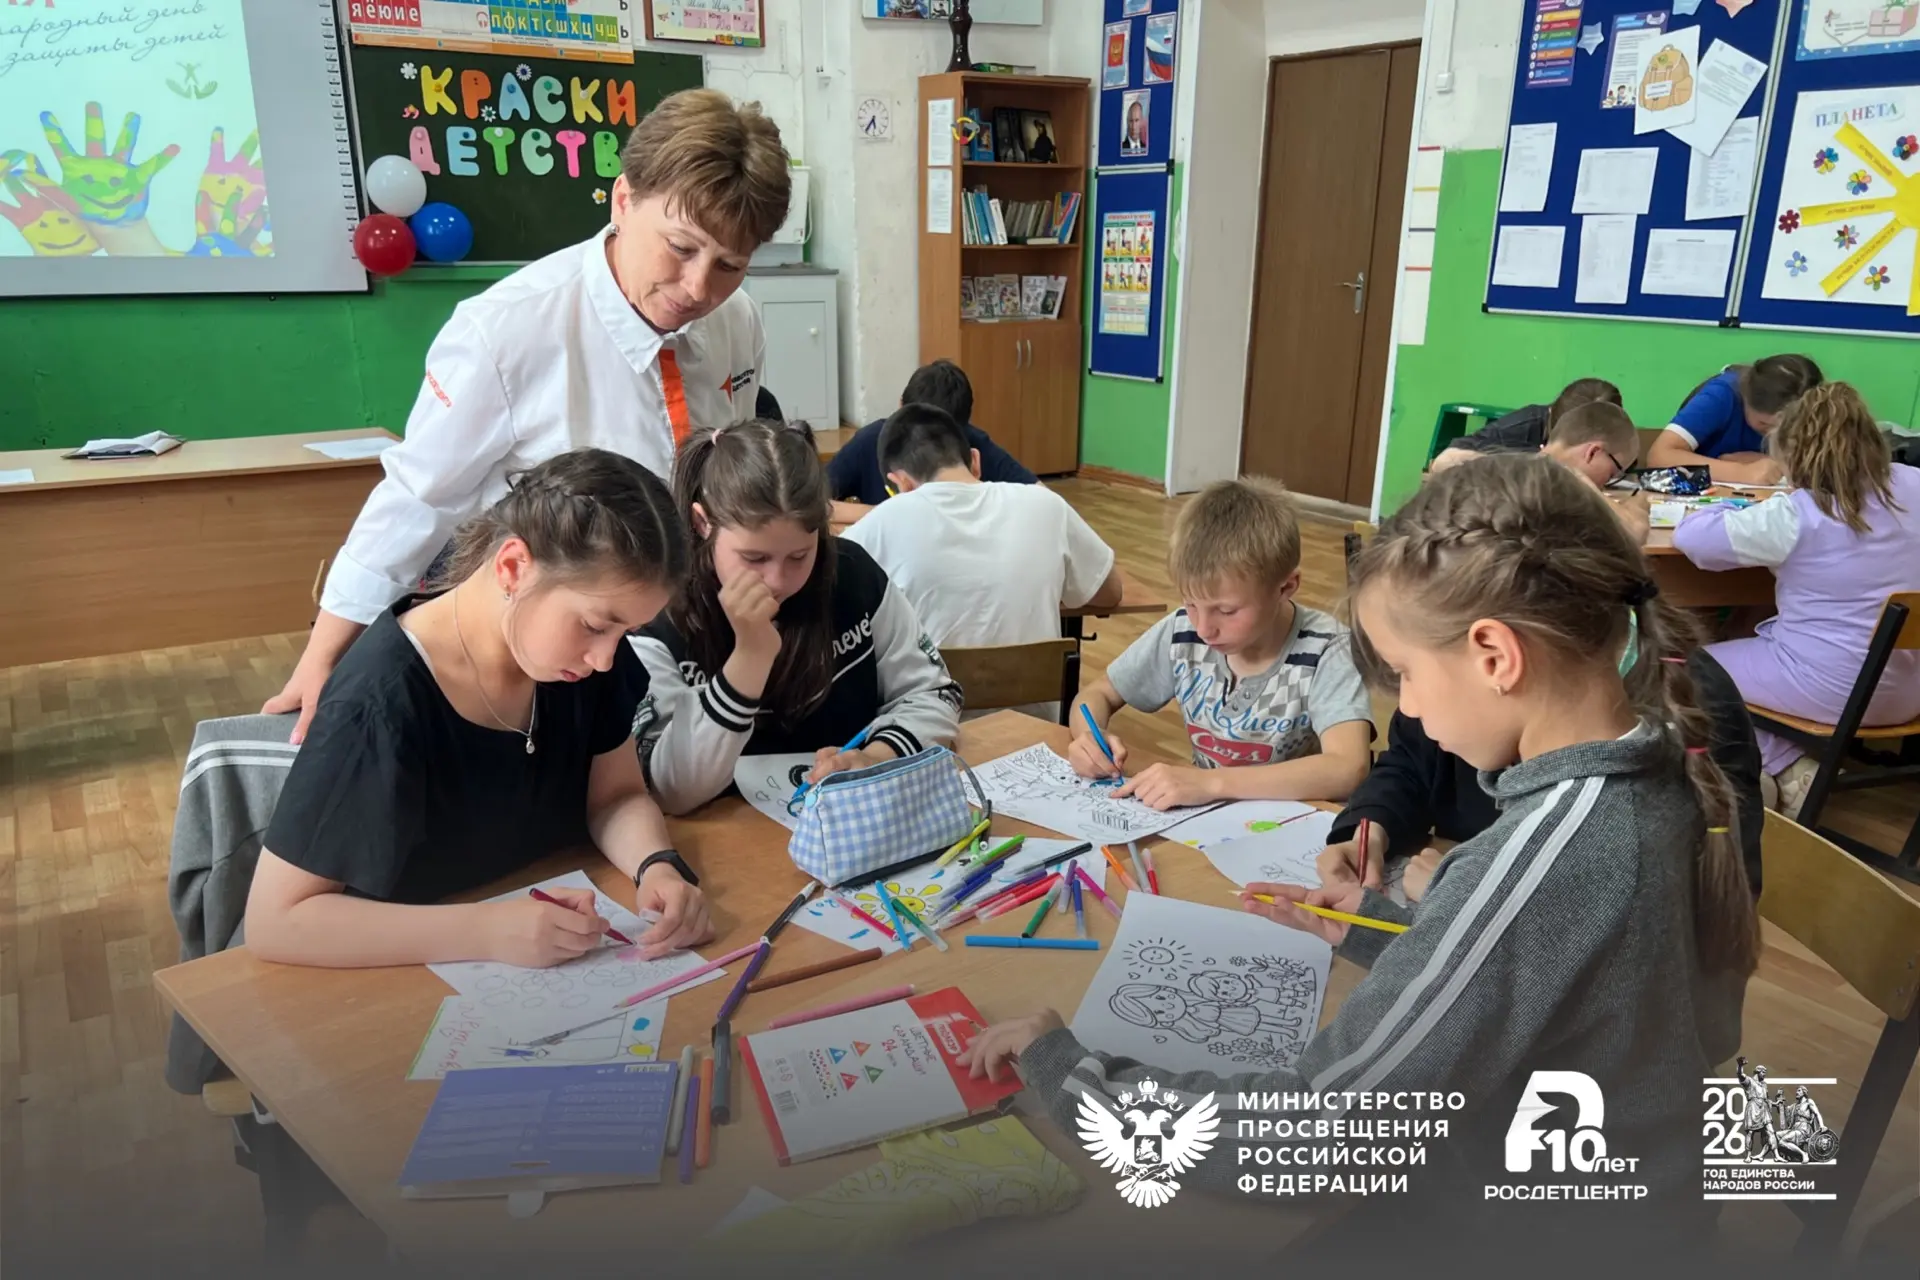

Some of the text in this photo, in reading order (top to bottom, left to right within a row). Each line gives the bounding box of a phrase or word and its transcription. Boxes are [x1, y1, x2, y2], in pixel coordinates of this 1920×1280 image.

[0, 24, 229, 77] защиты детей
[420, 65, 636, 127] КРАСКИ
[409, 126, 624, 178] ДЕТСТВ
